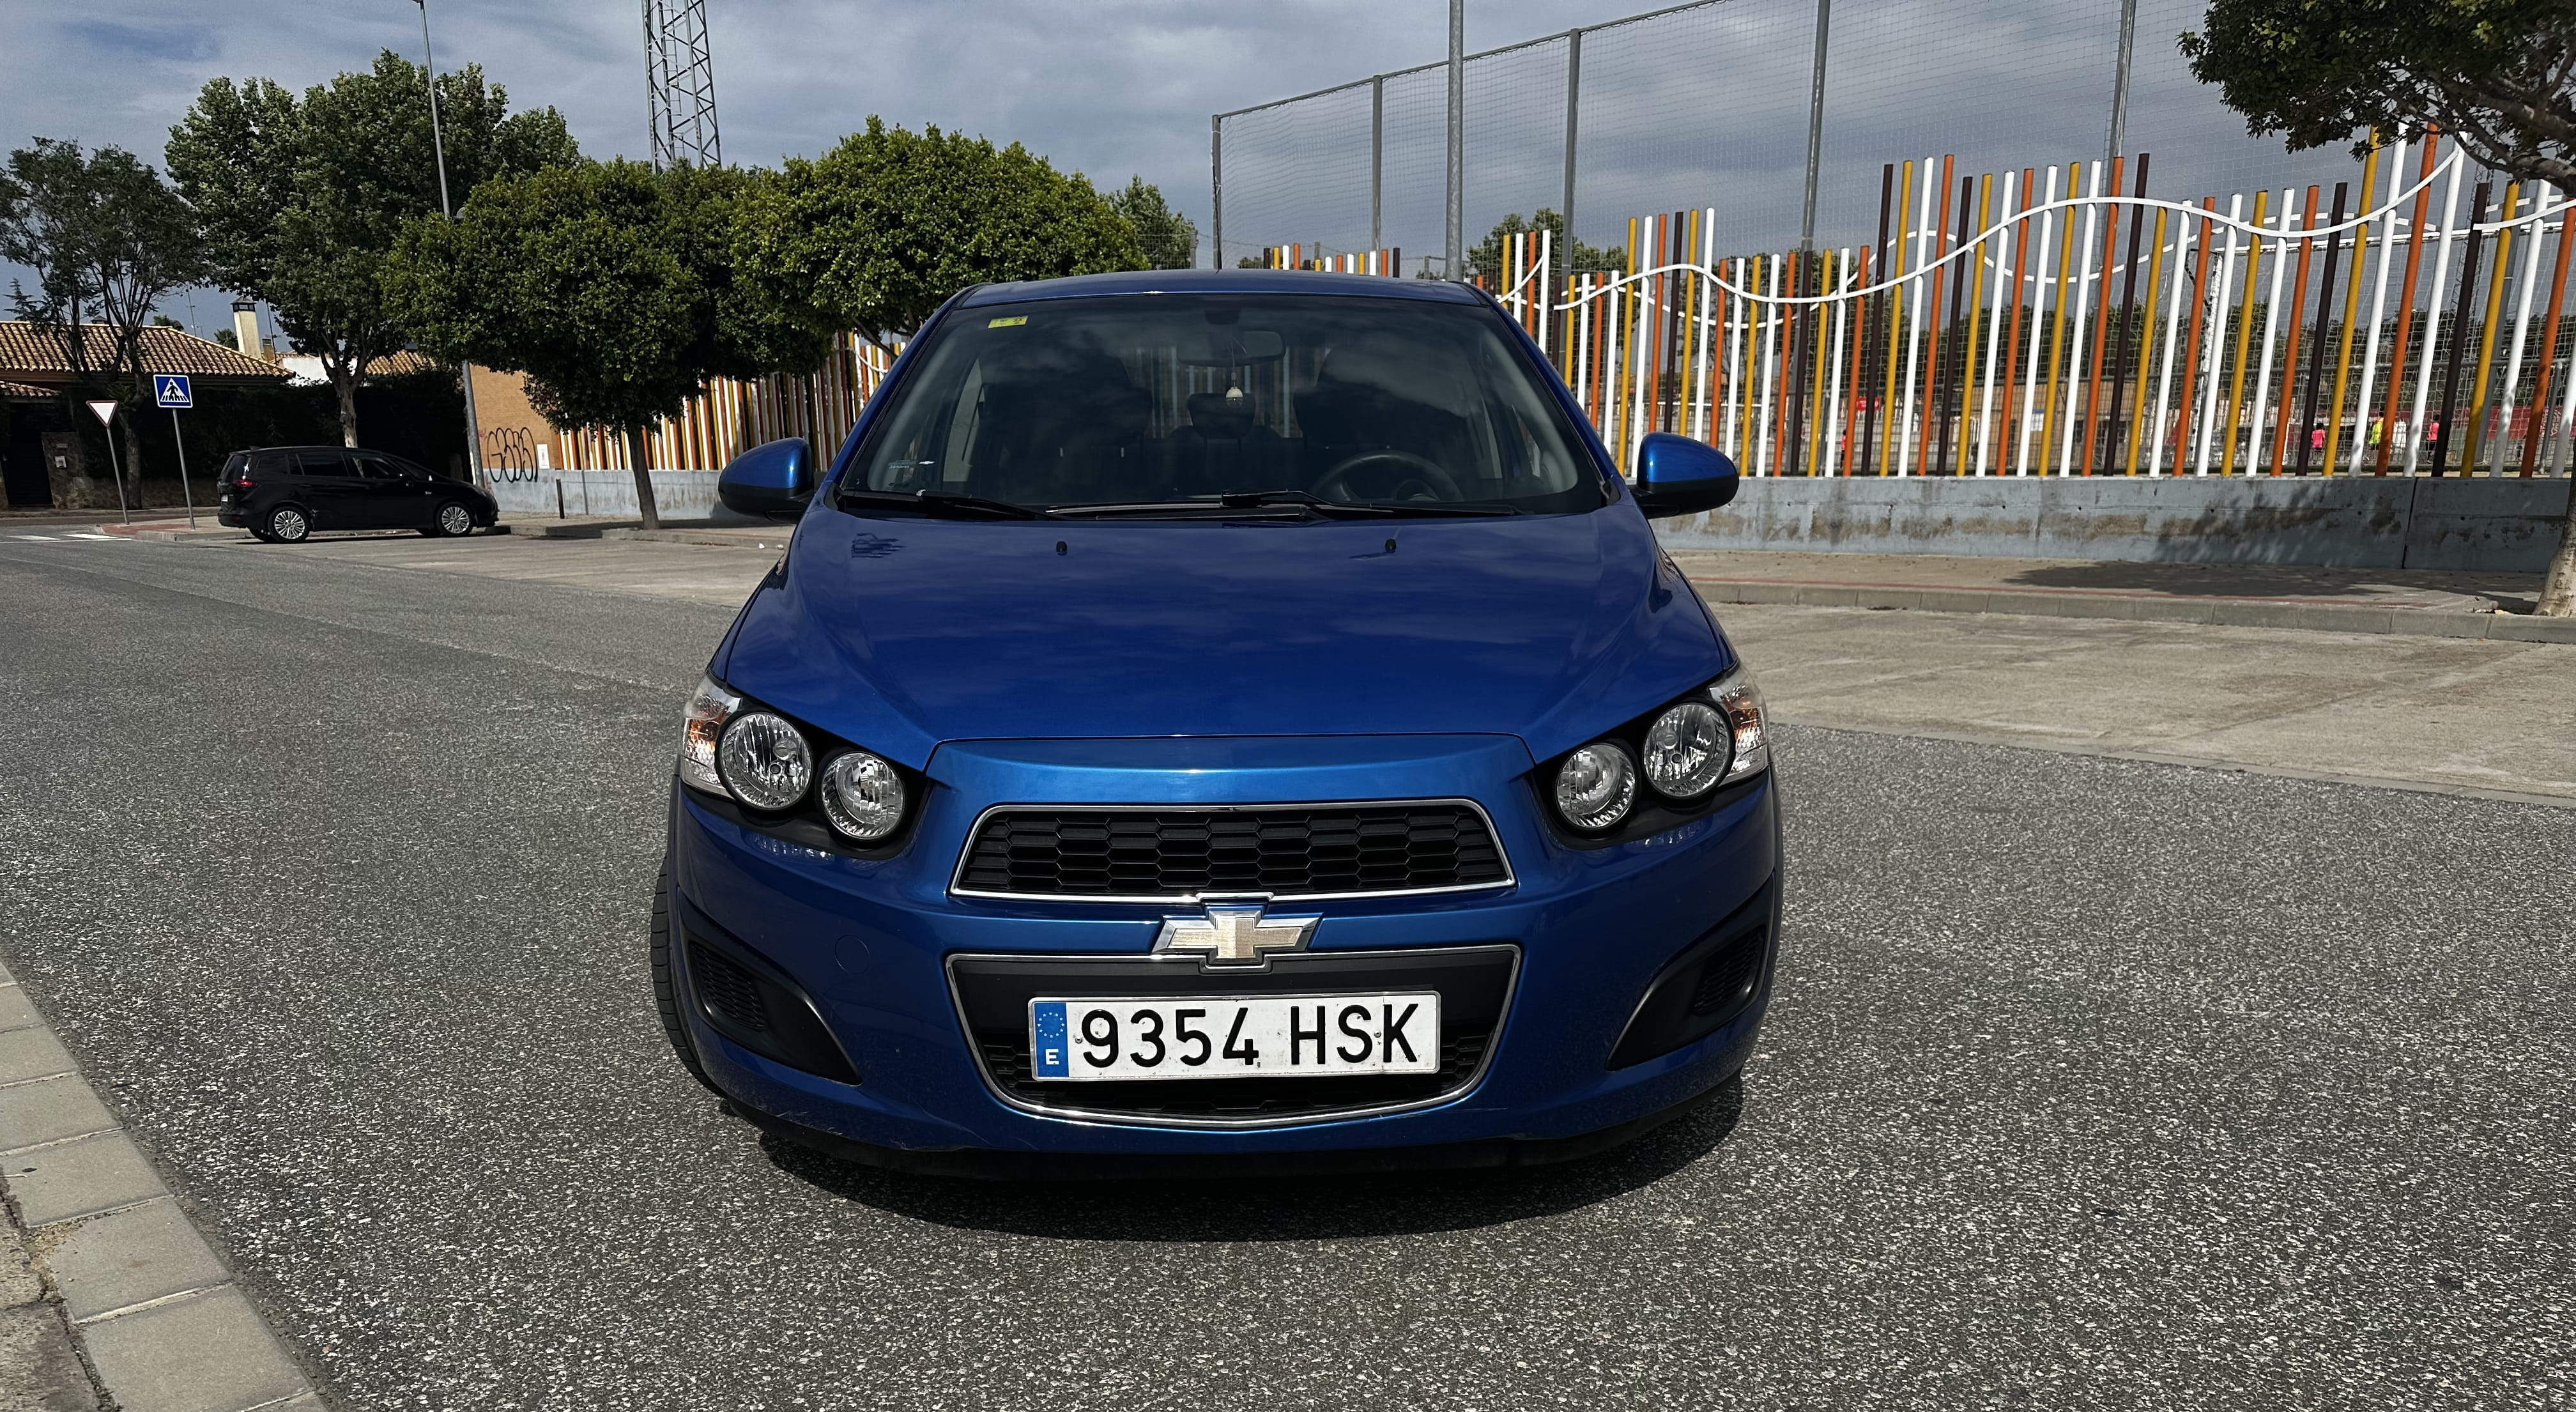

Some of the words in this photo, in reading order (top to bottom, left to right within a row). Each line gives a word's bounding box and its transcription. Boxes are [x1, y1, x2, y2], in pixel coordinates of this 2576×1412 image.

[1081, 1007, 1259, 1068] 9354
[1291, 1003, 1419, 1065] HSK
[1045, 1048, 1059, 1065] E
